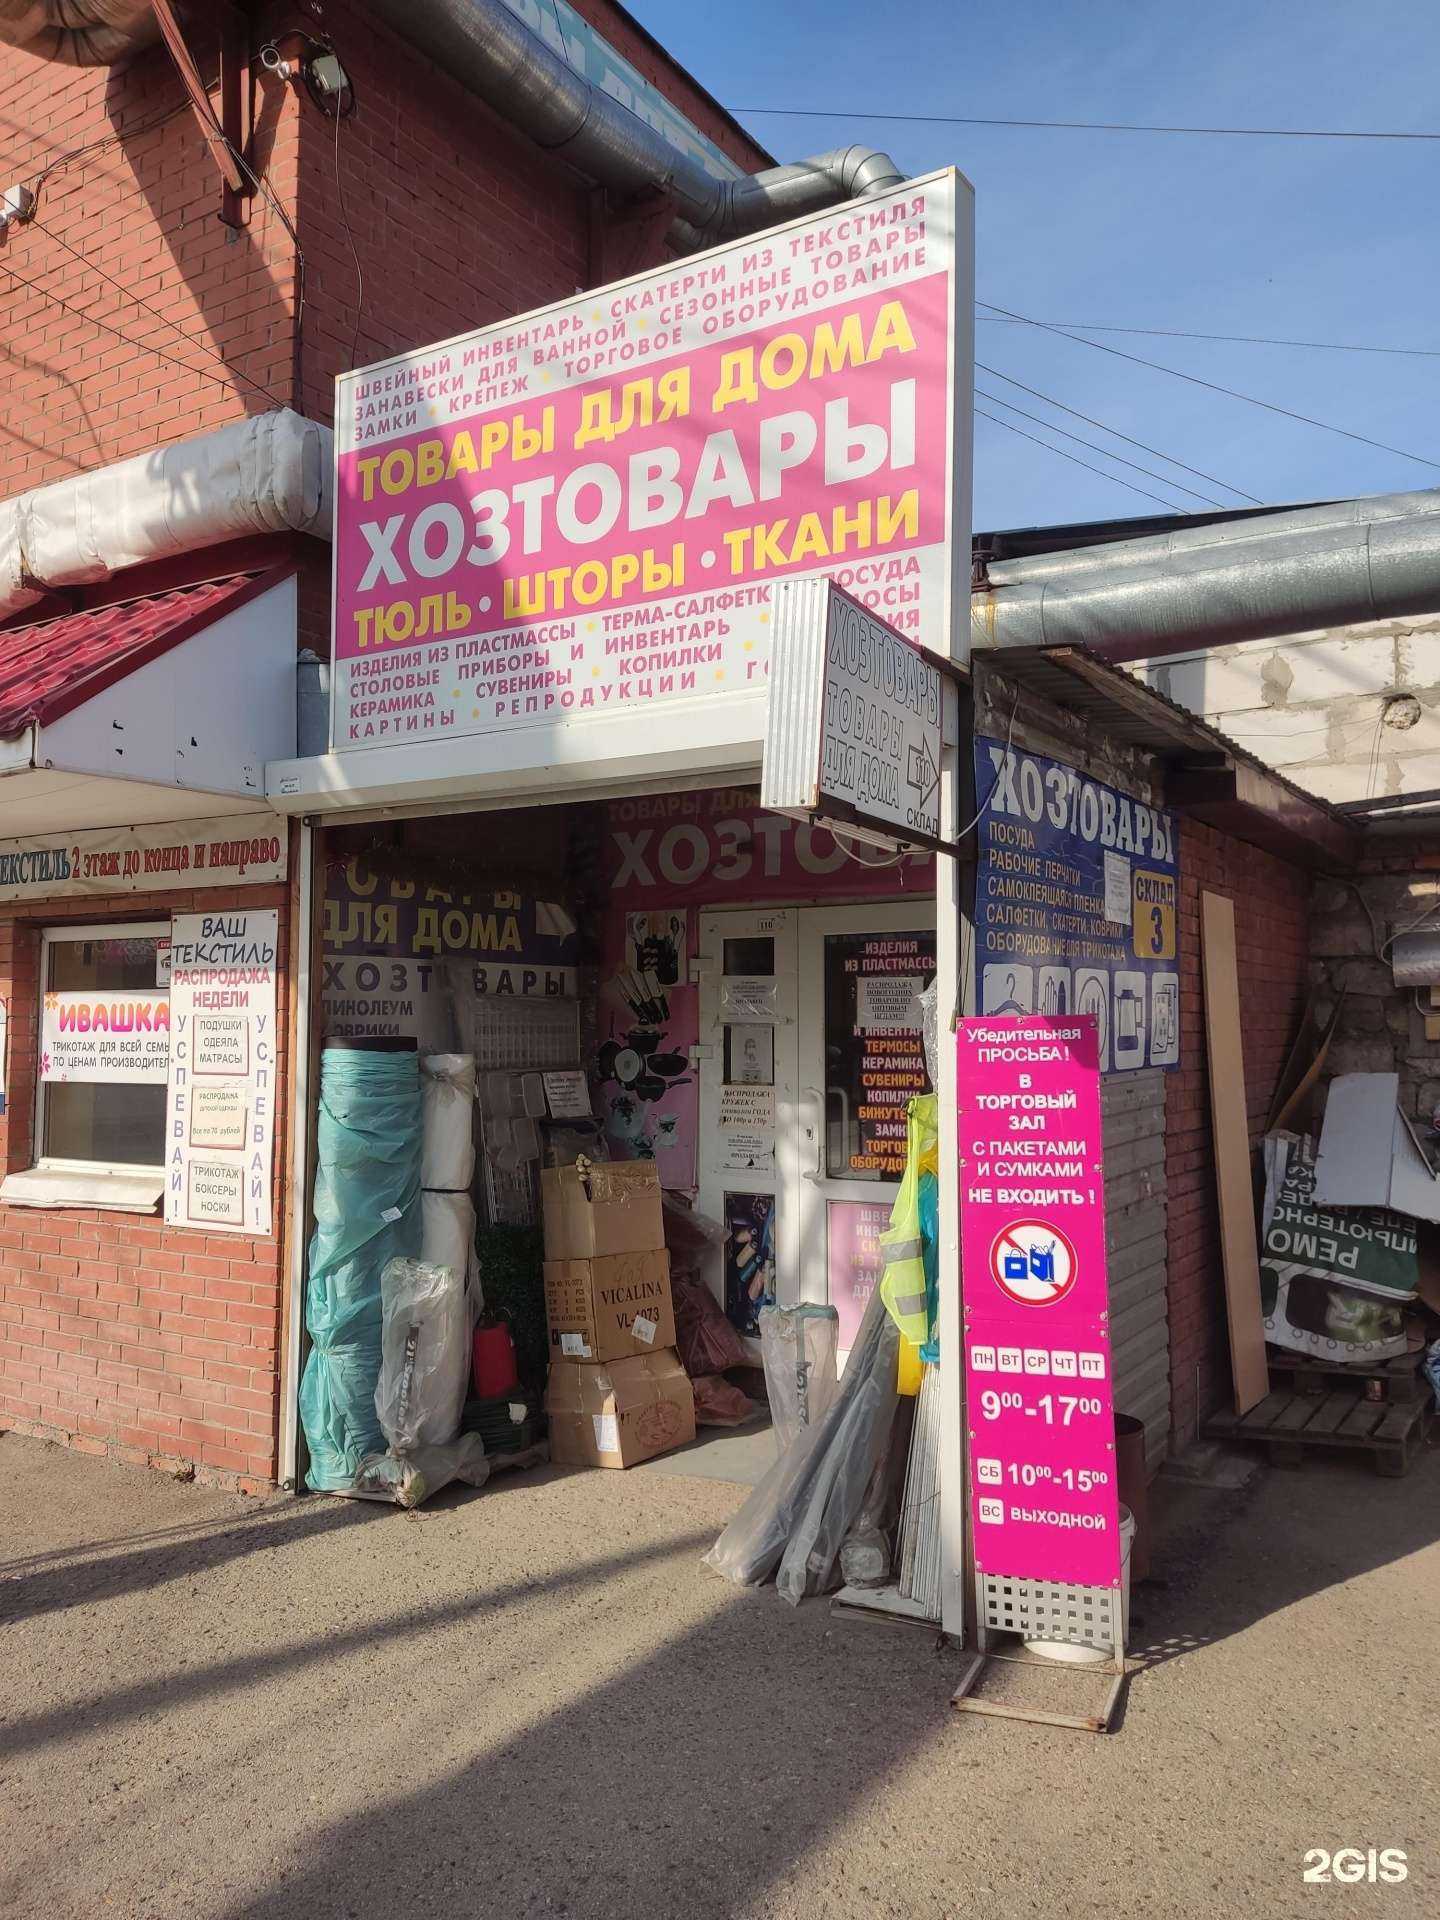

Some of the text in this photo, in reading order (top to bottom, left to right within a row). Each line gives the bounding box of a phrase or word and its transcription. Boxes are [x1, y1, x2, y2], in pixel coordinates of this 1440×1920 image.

[355, 196, 925, 400] ШВЕЙНЫЙ ИНВЕНТАРЬ СКАТЕРТИ ИЗ ТЕКСТИЛЯ
[354, 221, 925, 421] ЗАНАВЕСКИ ДЛЯ ВАННОЙ СЕЗОННЫЕ ТОВАРЫ
[354, 247, 926, 441] ЗАМКИ КРЕПЕЖ ТОРГОВОЕ ОБОРУДОВАНИЕ
[357, 301, 918, 501] ТОВАРЫ ДЛЯ ДОМА
[356, 377, 917, 592] ХОЗТОВАРЫ
[354, 490, 919, 648] ТЮЛЬ ШТОРЫ ТКАНИ
[350, 582, 920, 698] СТОЛОВЫЕ ПРИБОРЫ И ИНВЕНТАРЬ ОСЫ
[350, 651, 422, 678] ИЗДЕЛИЯ
[428, 646, 449, 665] ИЗ
[455, 623, 576, 660] ПЛАСТМАССЫ
[829, 598, 941, 728] ХОЗТОВАРЫ
[350, 692, 435, 719] КЕРАМИКА
[476, 669, 572, 699] СУВЕНИРЫ
[619, 642, 722, 676] КОПИЛКИ
[350, 671, 695, 739] КАРТИНЫ РЕПРОДУКЦИИ
[828, 680, 903, 760] ТОВАРЫ
[823, 735, 900, 809] ДЛЯ ДОМА
[915, 755, 931, 788] 110
[608, 796, 701, 823] ТОВАРЫ
[989, 746, 1174, 864] ХОЗТОВАРЫ
[906, 807, 939, 838] СКЛАД
[989, 820, 1035, 850] ПОСУДА
[71, 846, 81, 878] 2
[84, 852, 121, 878] этаж
[122, 850, 140, 879] до
[144, 846, 190, 875] конца
[194, 844, 206, 868] и
[209, 836, 280, 875] направо
[610, 816, 935, 888] ХОЗТО
[990, 849, 1080, 887] РАБОЧИЕ ПЕРЧАТКИ
[988, 876, 1105, 916] САМОКЛЕЯЩАЯСЯ ПЛЕНКА
[1135, 876, 1176, 910] СКЛАД
[201, 917, 247, 938] ВАШ
[323, 900, 523, 954] ДЛЯ ДОМА
[1150, 906, 1163, 954] 3
[172, 942, 274, 964] ТЕКСТИЛЬ
[865, 941, 918, 955] ИЗДЕЛИЯ
[986, 930, 1126, 961] ОБОРУДОВАНИЕ ДЛЯ ТРИКОТАЖА
[174, 967, 271, 987] РАСПРОДАЖА
[322, 962, 565, 996] ХОЗТВАРЫ
[844, 959, 859, 972] ИЗ
[193, 991, 249, 1010] НЕДЕЛИ
[59, 1002, 170, 1032] ИВАШКА
[200, 1020, 242, 1031] ПОДУШКИ
[52, 1041, 95, 1052] ТРИКОТАЖ
[99, 1041, 116, 1054] ДЛЯ
[120, 1040, 141, 1053] ВСЕЙ
[203, 1037, 239, 1048] ОДЕЯЛА
[865, 1041, 920, 1053] ТЕРМОСЫ
[967, 1028, 1081, 1044] Убедительная
[53, 1056, 64, 1067] ПО
[68, 1056, 97, 1069] ЦЕНАМ
[200, 1053, 242, 1064] МАТРАСЫ
[863, 1057, 925, 1070] КЕРАМИКА
[862, 1074, 925, 1087] СУВЕНИРЫ
[1019, 1073, 1032, 1089] В
[976, 1089, 1077, 1110] ТОРГОВЫЙ
[1008, 1116, 1046, 1130] ЗАЛ
[972, 1141, 1086, 1156] С ПАКЕТАМИ
[194, 1166, 239, 1178] ТРИКОТАЖ
[977, 1162, 1083, 1177] И СУМКАМИ
[195, 1183, 237, 1196] БОКСЕРЫ
[968, 1188, 992, 1204] НЕ
[201, 1201, 230, 1213] НОСКИ
[1267, 1229, 1360, 1269] РЕМО
[601, 1281, 663, 1304] VICALINA
[974, 1353, 1101, 1371] ПН ВТ СР ЧТ ПТ
[979, 1465, 999, 1478] СБ
[982, 1505, 1107, 1531] ВС ВЫХОДНОЙ
